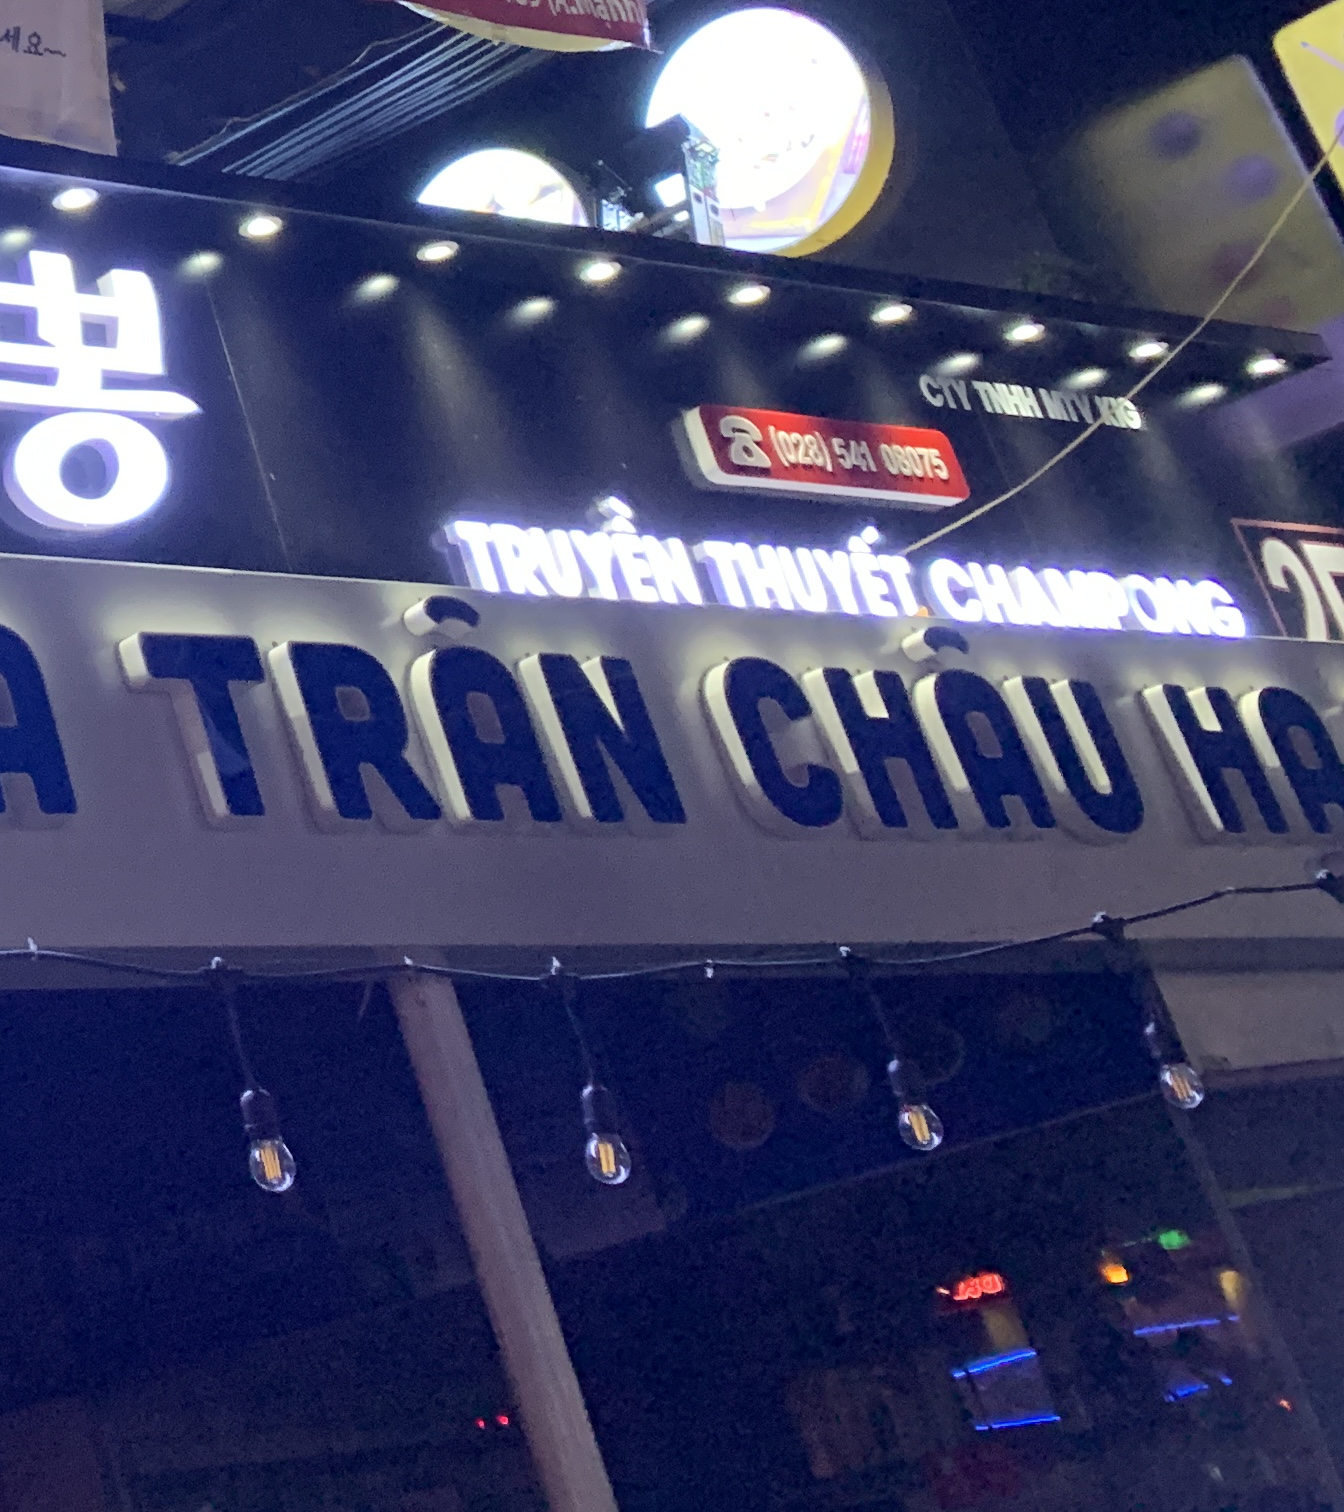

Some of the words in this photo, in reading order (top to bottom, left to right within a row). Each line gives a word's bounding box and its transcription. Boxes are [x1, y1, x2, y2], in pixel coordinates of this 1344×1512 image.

[919, 373, 973, 410] CTY
[971, 379, 1044, 419] TNHH
[767, 424, 834, 473] (028)
[831, 436, 879, 473] 541
[444, 495, 705, 606] TRUYỀN
[694, 525, 914, 617] THUYẾT
[926, 557, 1246, 638] CHAMPONG
[118, 594, 687, 826] TRÂN
[703, 625, 1146, 836] CHÂU
